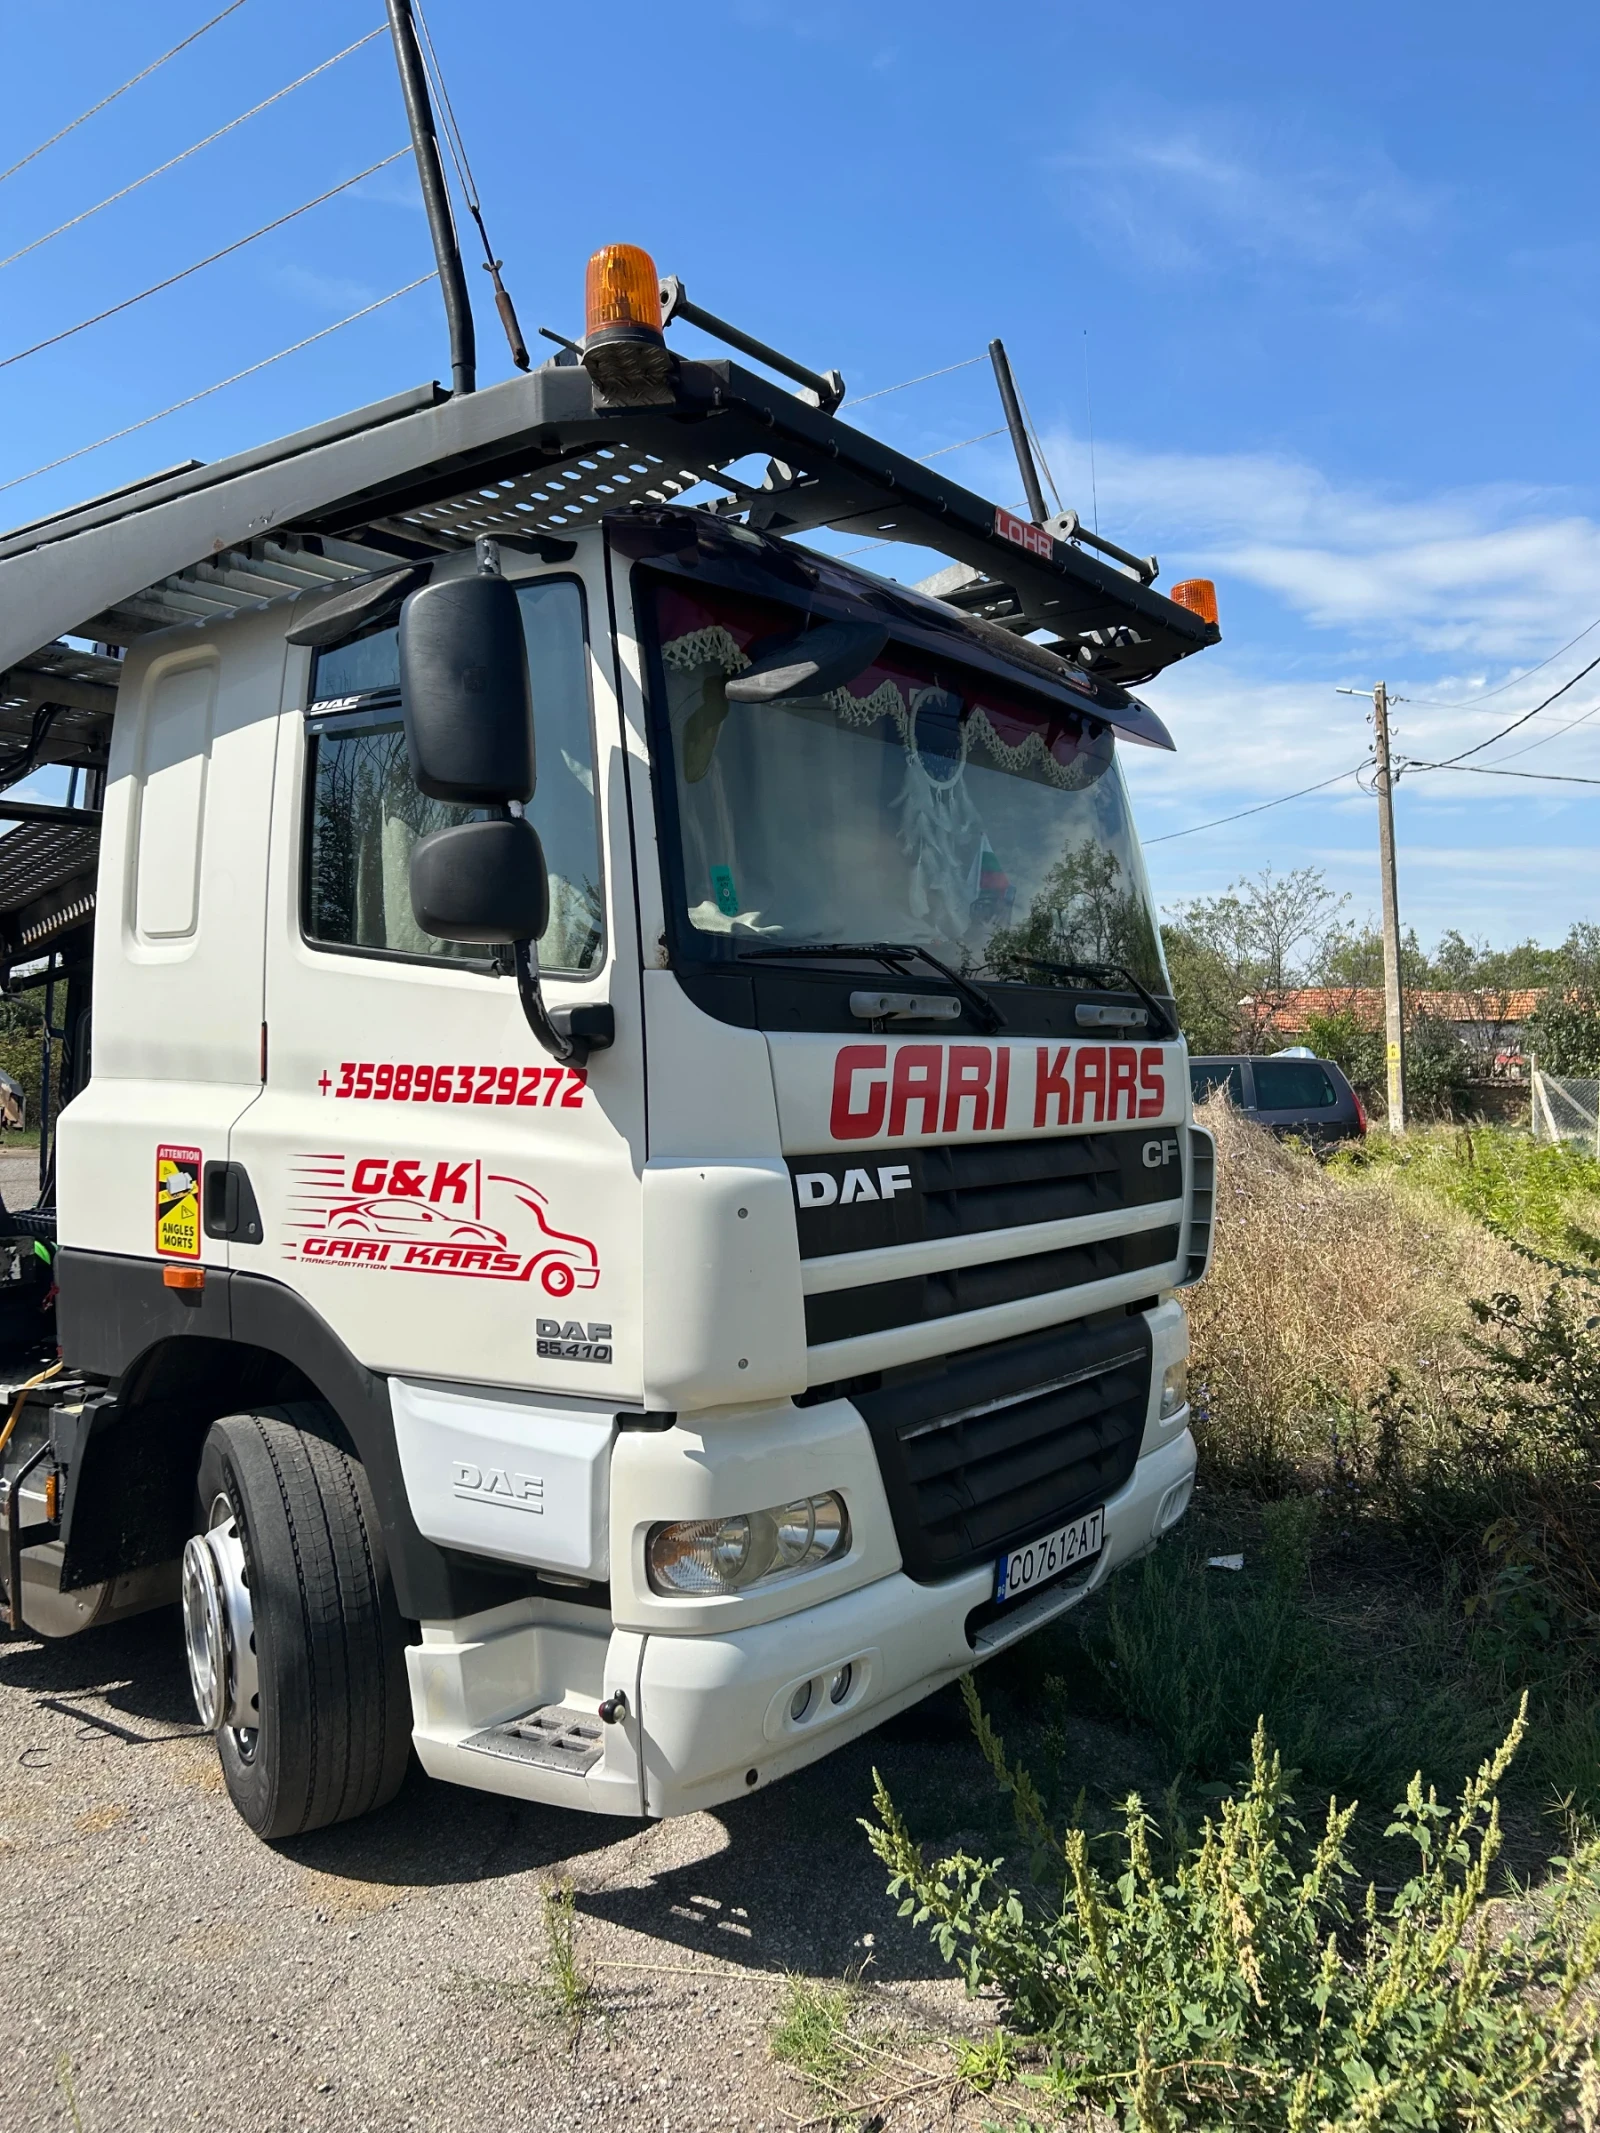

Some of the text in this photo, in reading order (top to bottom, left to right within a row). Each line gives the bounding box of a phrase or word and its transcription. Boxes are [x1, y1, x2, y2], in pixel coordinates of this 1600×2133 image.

[997, 513, 1052, 560] LOHR
[310, 695, 362, 711] DAF
[318, 1062, 588, 1108] +359896329272
[829, 1044, 1165, 1141] GARI KARS
[159, 1148, 200, 1160] ATTENTION
[1142, 1139, 1178, 1168] CF
[351, 1159, 474, 1204] G&K
[795, 1165, 912, 1208] DAF
[162, 1222, 195, 1237] ANGLES
[164, 1235, 193, 1249] MORTS
[300, 1257, 388, 1270] TRANSPORTATION
[302, 1238, 523, 1272] GARI KARS
[536, 1318, 612, 1342] DAF
[537, 1341, 609, 1360] 85.410
[452, 1461, 544, 1500] DAF
